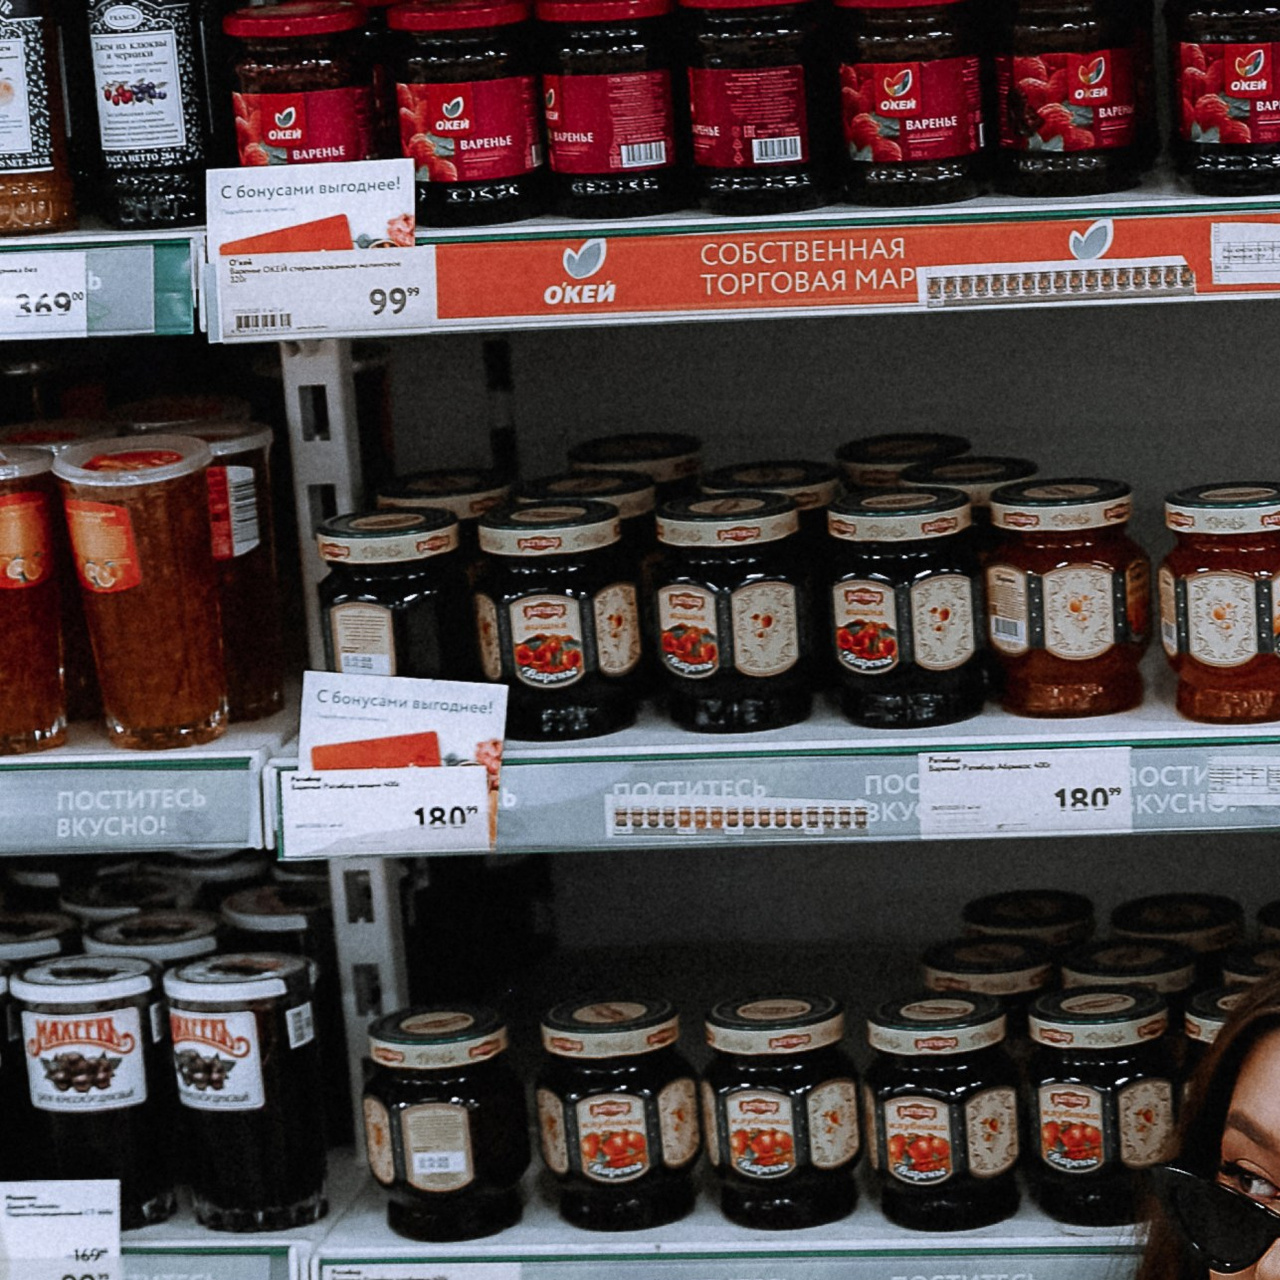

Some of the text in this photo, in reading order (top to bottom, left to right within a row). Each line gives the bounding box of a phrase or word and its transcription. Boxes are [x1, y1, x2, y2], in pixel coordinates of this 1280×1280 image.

[905, 115, 957, 130] ВАРЕНЬЕ
[293, 146, 346, 160] ВАРЕНЬЕ
[460, 135, 513, 151] ВАРЕНЬЕ
[220, 175, 402, 201] С бонусами выгоднее!
[700, 237, 905, 266] СОБСТВЕННАЯ
[544, 280, 616, 305] О'КЕЙ
[700, 267, 915, 296] ТОРГОВАЯ МАР
[369, 286, 420, 316] 99 99
[316, 688, 495, 715] С бонусами выгоднее!
[57, 788, 207, 811] ПОСТИТЕСЬ
[1054, 787, 1122, 810] 180 99
[57, 815, 166, 838] ВКУСНО!
[414, 806, 466, 828] 180
